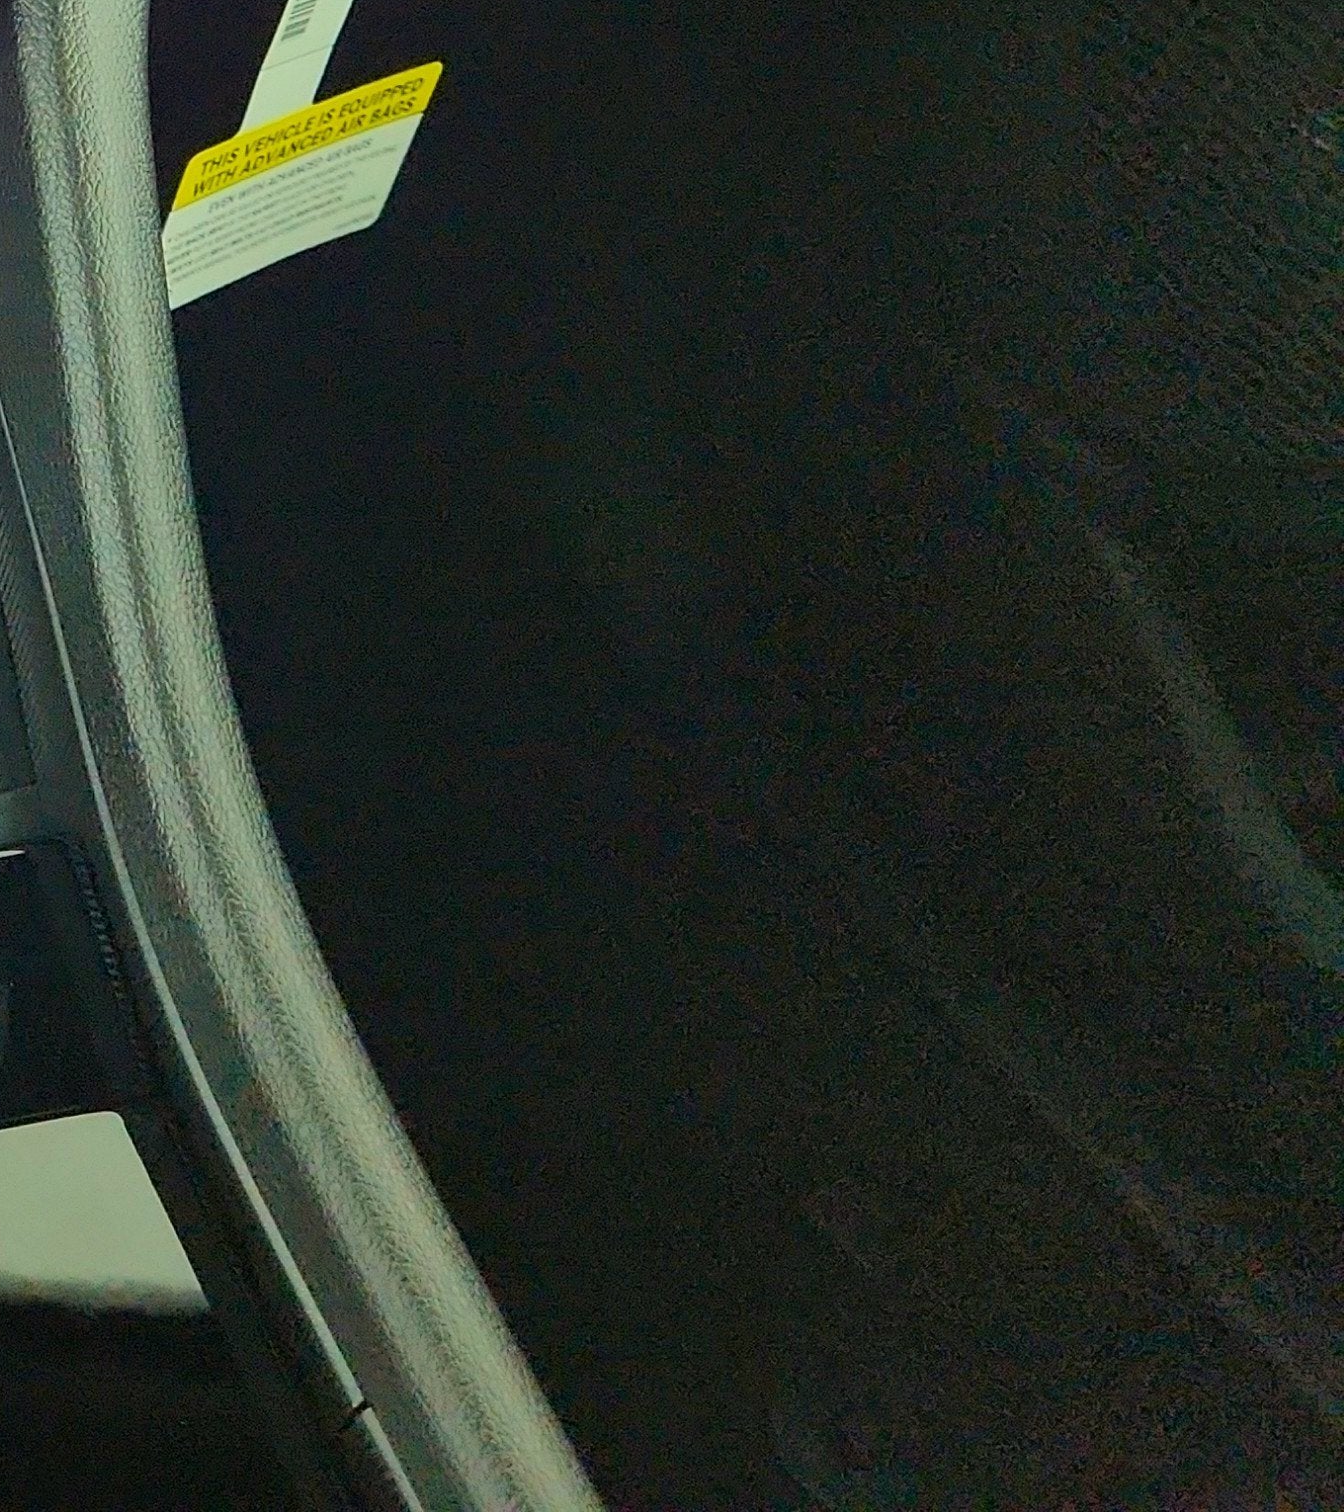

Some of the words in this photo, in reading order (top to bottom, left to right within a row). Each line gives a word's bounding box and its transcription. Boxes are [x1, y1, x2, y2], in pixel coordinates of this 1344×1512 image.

[192, 168, 236, 197] WITH
[241, 128, 334, 176] ADVANCED
[338, 113, 366, 134] AIR
[368, 96, 418, 125] BAGS
[201, 146, 240, 176] THIS
[244, 116, 313, 157] VEHICLE
[316, 107, 336, 125] IS
[338, 77, 426, 119] EQUIPPED
